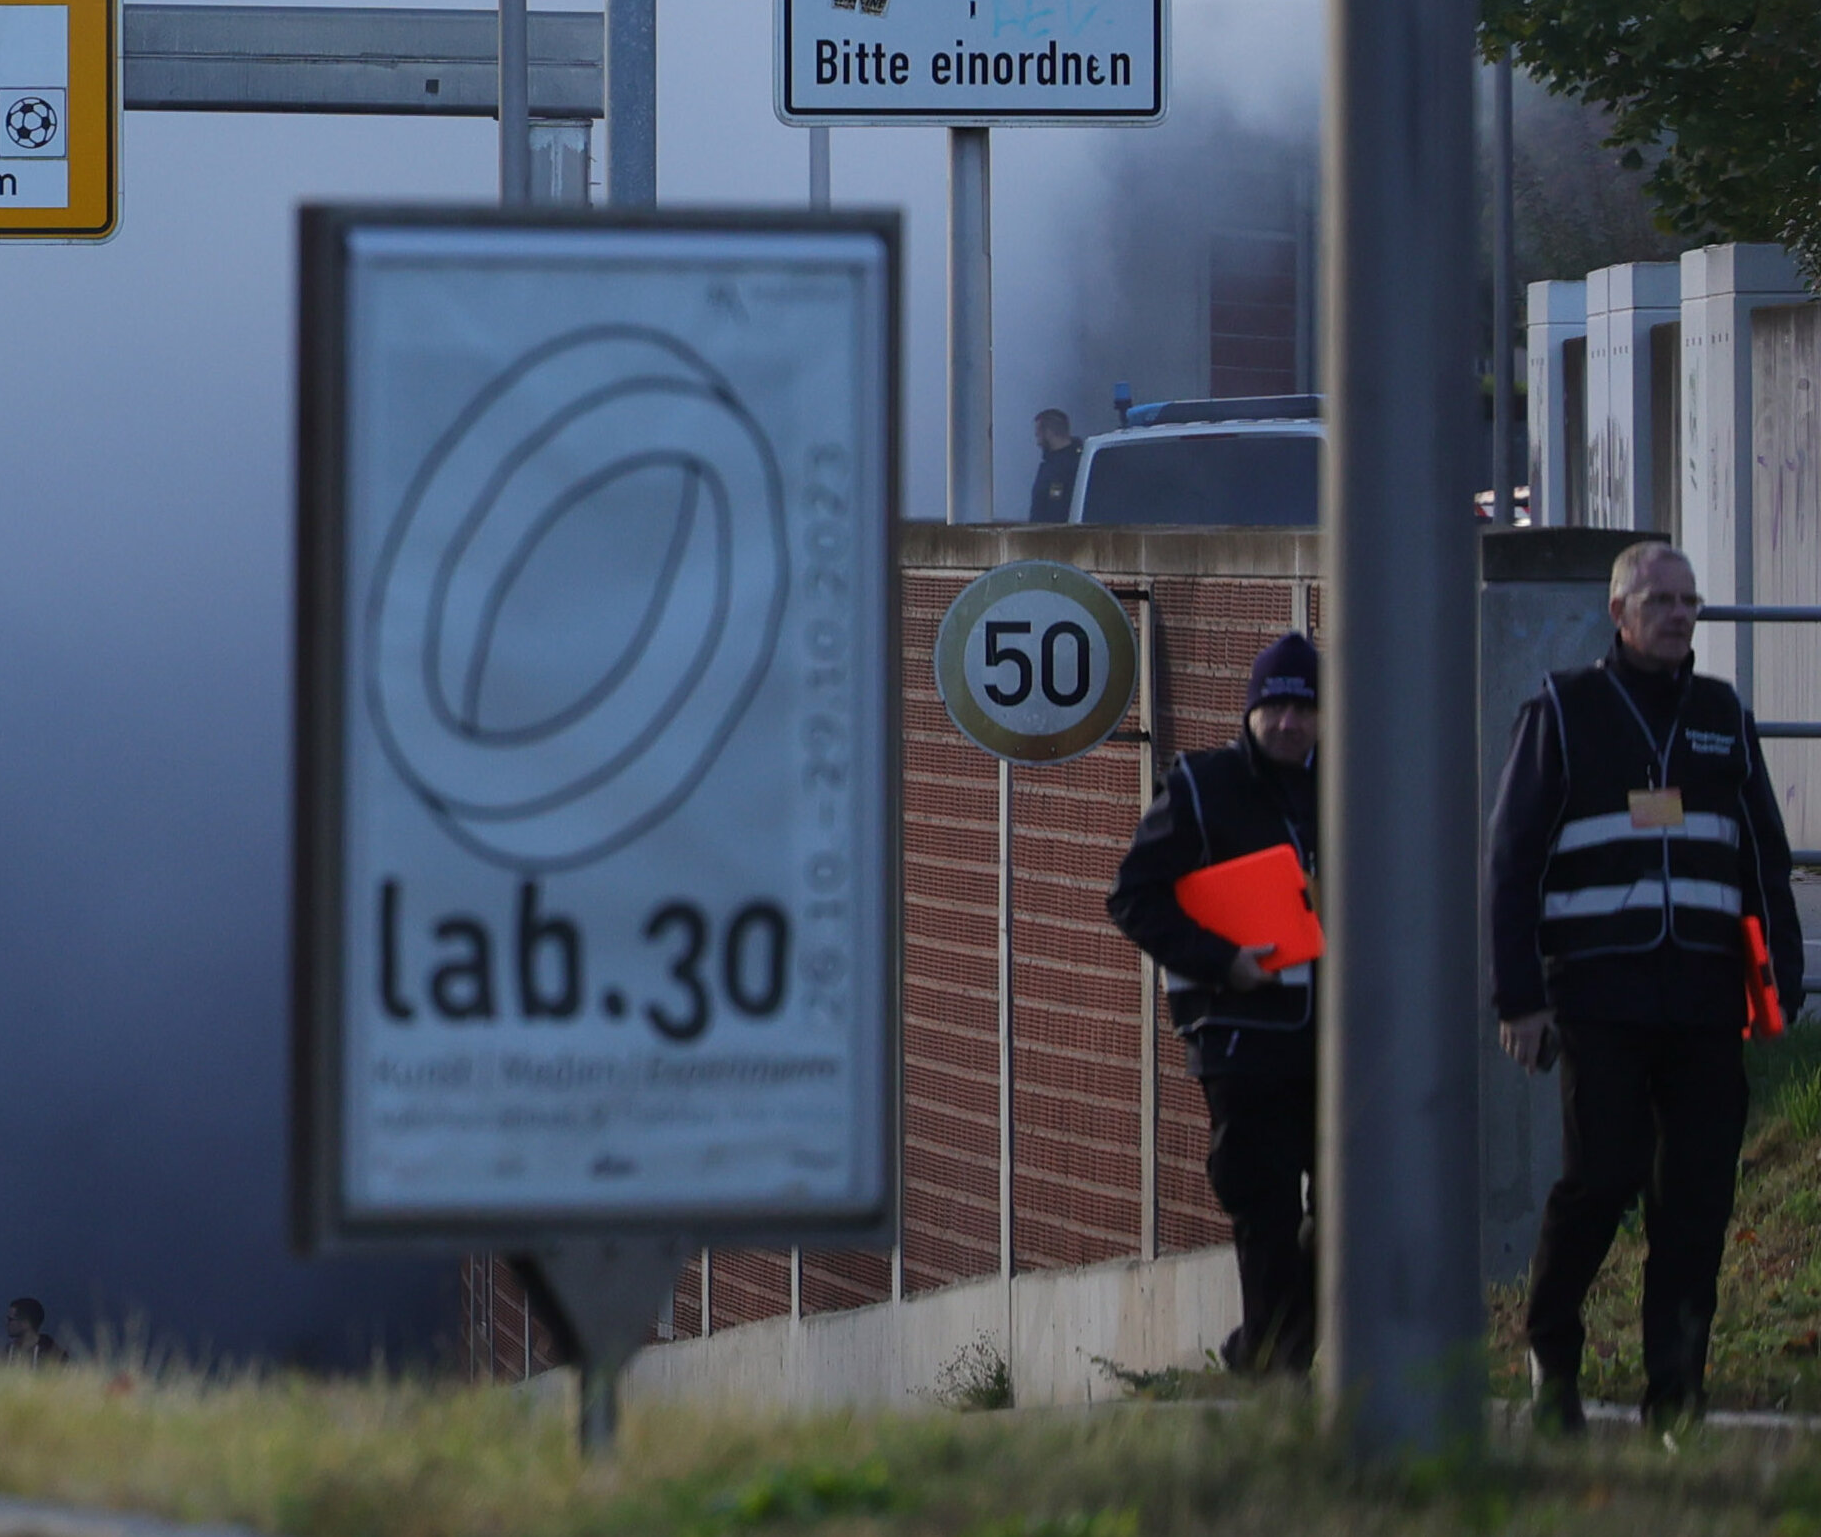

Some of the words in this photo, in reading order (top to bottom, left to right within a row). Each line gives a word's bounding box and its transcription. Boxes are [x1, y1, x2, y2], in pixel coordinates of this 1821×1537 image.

[816, 39, 908, 85] Bitte
[932, 40, 1130, 85] einordnen
[983, 620, 1091, 708] 50
[377, 874, 793, 1045] lab.30
